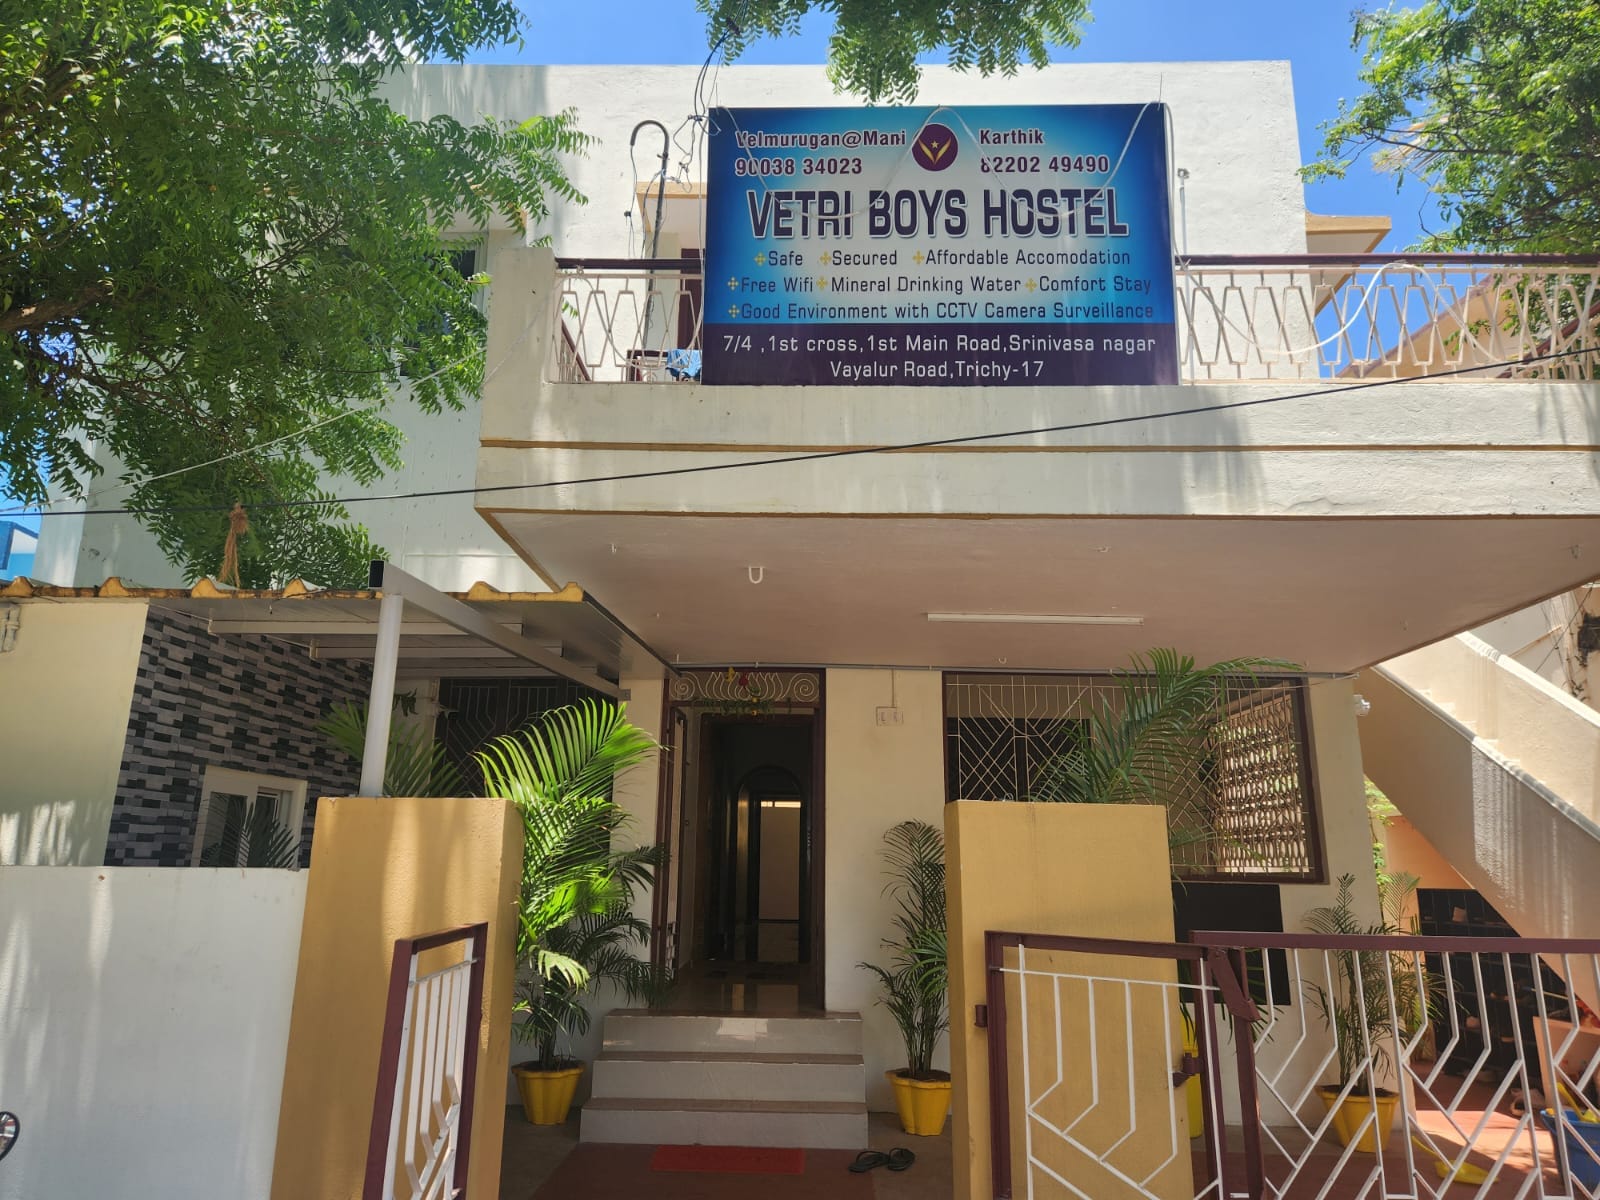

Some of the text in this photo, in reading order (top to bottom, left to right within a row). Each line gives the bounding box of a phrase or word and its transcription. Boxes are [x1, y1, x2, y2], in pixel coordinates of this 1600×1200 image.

[736, 131, 906, 149] Velmurugan@Mani
[980, 129, 1043, 144] Karthik
[803, 158, 862, 174] 34023
[1049, 156, 1109, 172] 49490
[748, 188, 1129, 237] VETRI BOYS HOSTEL
[768, 249, 1130, 266] Safe Secured Affordable Accomodation
[741, 275, 1151, 295] Free Wifi Mineral Drinking Water Comfort Stay
[741, 303, 1153, 319] Good Environment with CCTV Camera Surveillance
[723, 335, 752, 352] 7/4
[906, 335, 948, 351] Main
[1103, 338, 1155, 354] nagar
[831, 361, 898, 380] Vayalur
